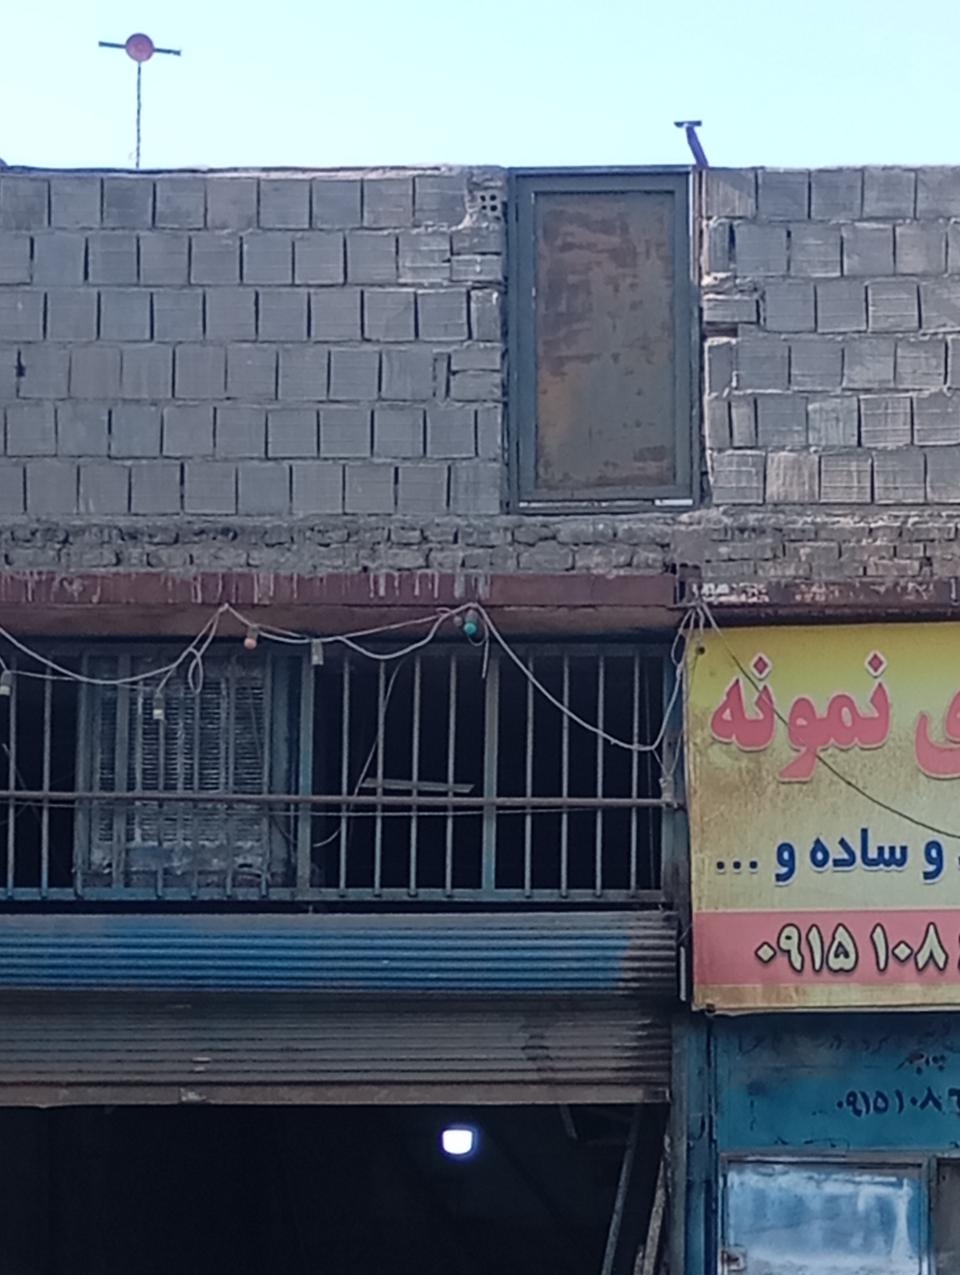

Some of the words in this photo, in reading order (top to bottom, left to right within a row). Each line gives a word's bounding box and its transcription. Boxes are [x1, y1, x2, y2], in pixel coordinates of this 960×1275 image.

[709, 651, 893, 782] نمونه
[774, 841, 797, 885] و
[808, 827, 909, 870] ساده
[921, 837, 945, 881] و
